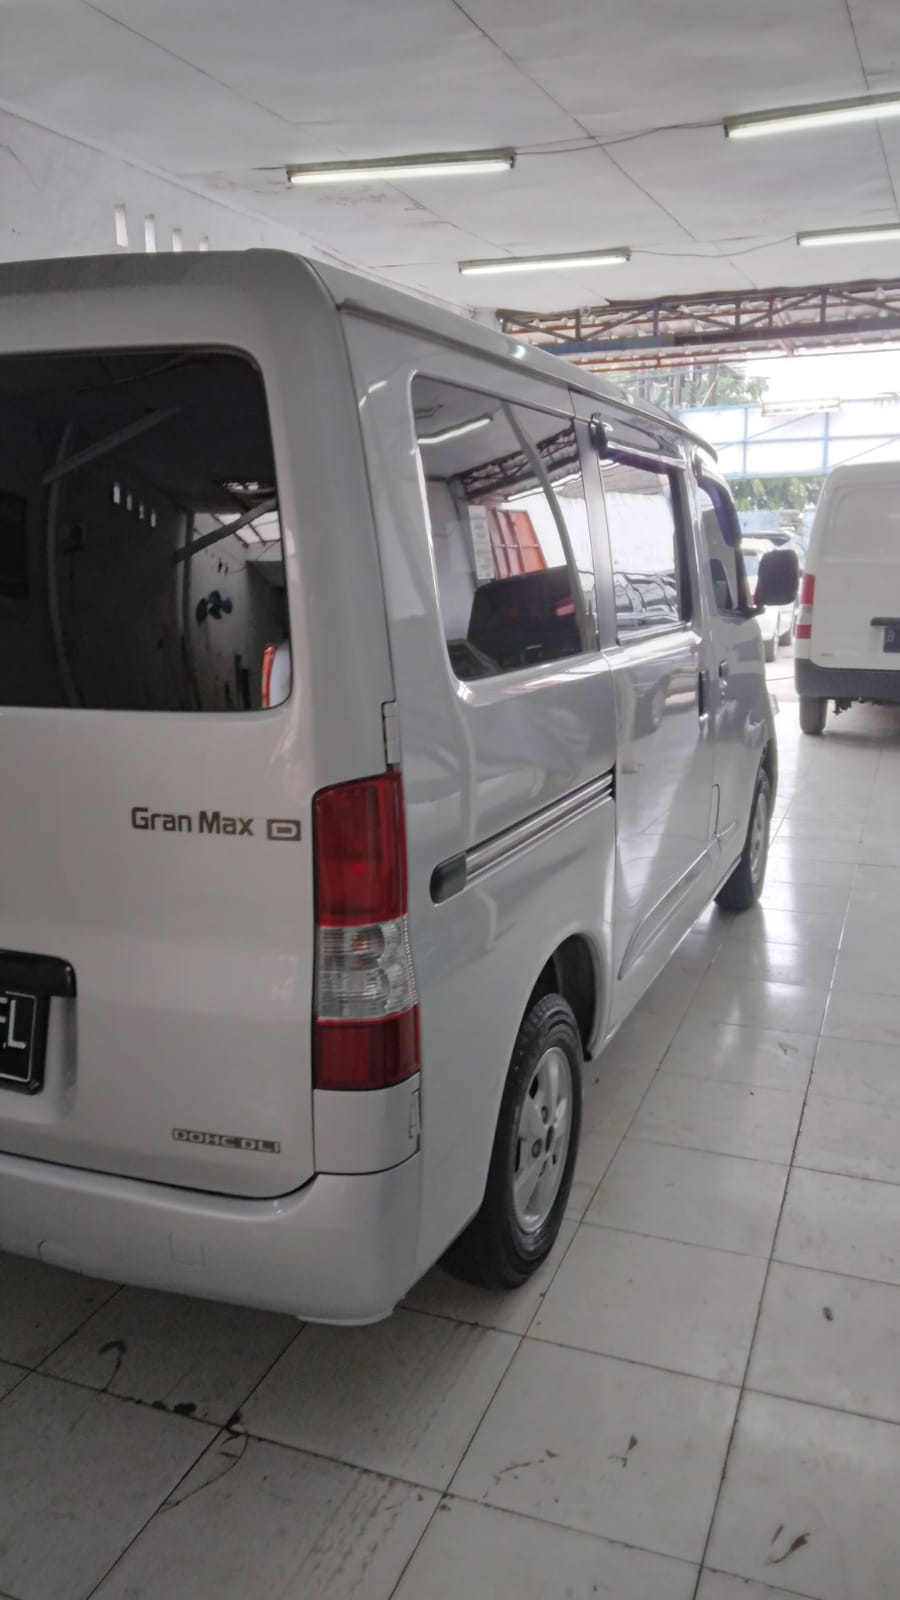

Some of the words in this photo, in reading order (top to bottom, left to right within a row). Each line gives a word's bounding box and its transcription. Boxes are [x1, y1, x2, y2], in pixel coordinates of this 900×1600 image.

[131, 807, 192, 832] Gran
[199, 811, 254, 836] Max
[173, 1129, 236, 1148] DOHC
